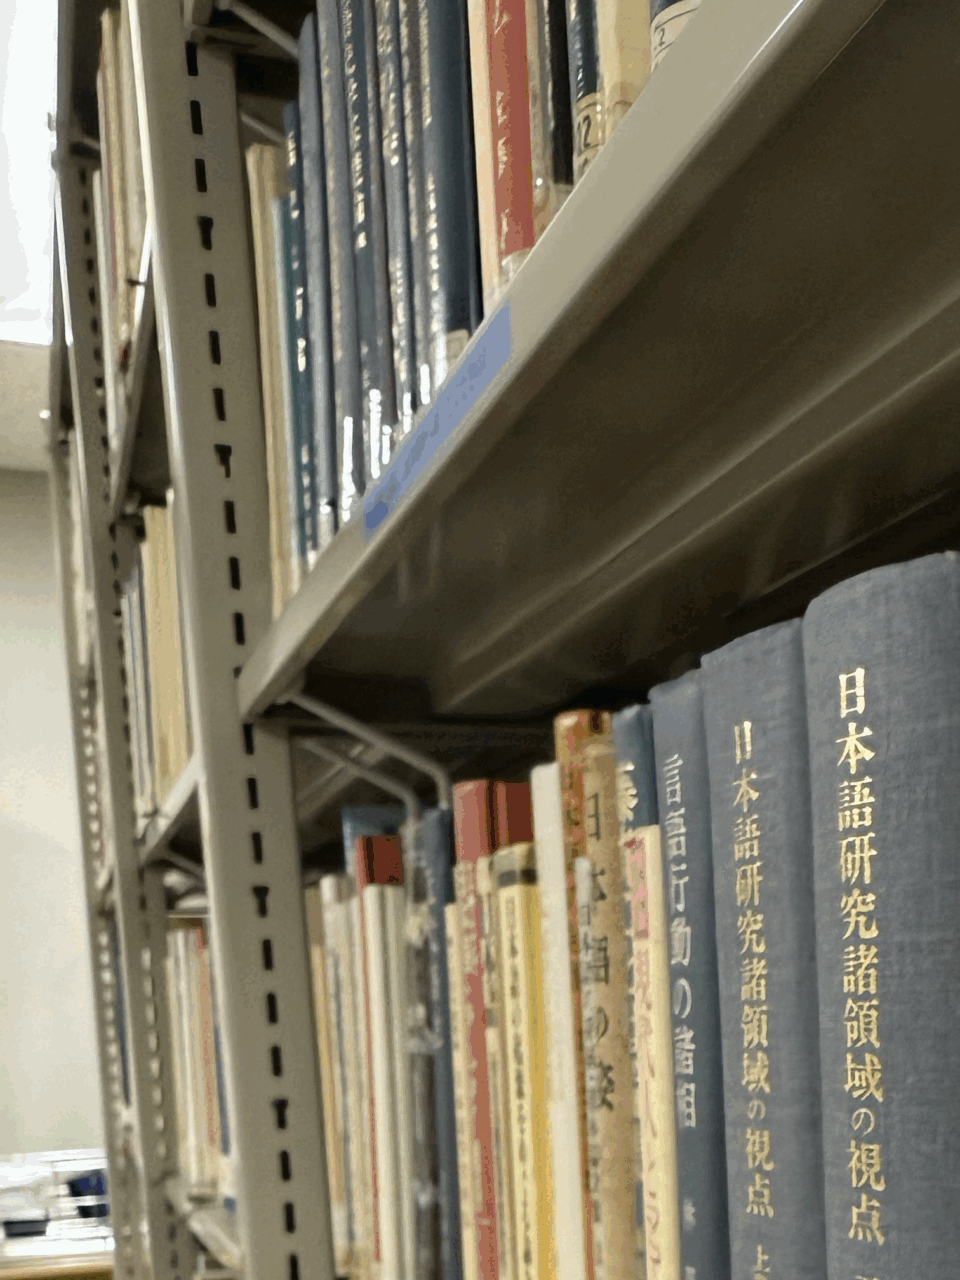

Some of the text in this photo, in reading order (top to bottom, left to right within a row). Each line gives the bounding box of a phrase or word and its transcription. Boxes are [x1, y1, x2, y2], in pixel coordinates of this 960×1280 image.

[732, 720, 775, 1218] 日本語研究諸領域の視点
[836, 666, 886, 1245] 日本語研究諸領域の視点
